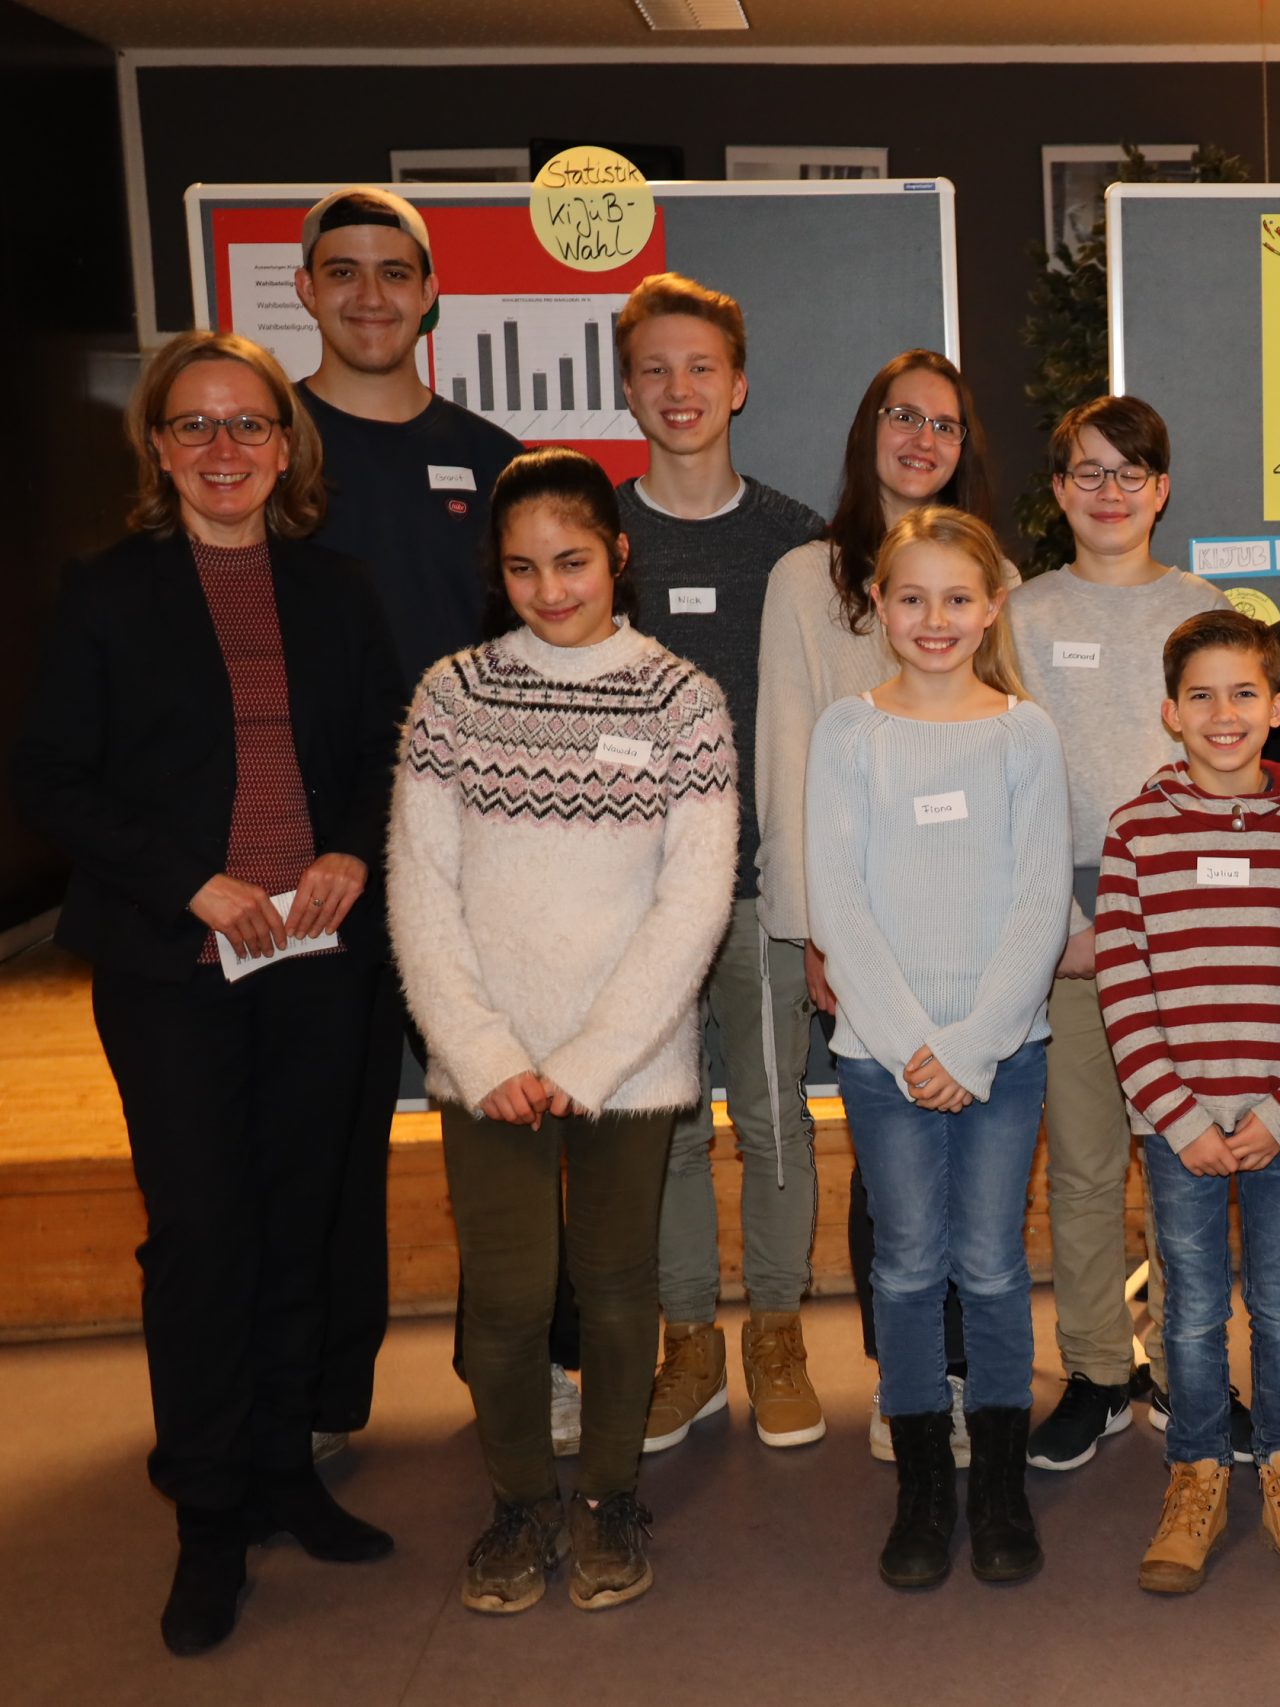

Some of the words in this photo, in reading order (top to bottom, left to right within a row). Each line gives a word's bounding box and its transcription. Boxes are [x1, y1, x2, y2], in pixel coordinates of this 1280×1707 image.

[542, 157, 639, 188] Statistik
[556, 225, 633, 261] Wahl
[678, 595, 702, 605] Nick
[1206, 867, 1240, 879] Julius
